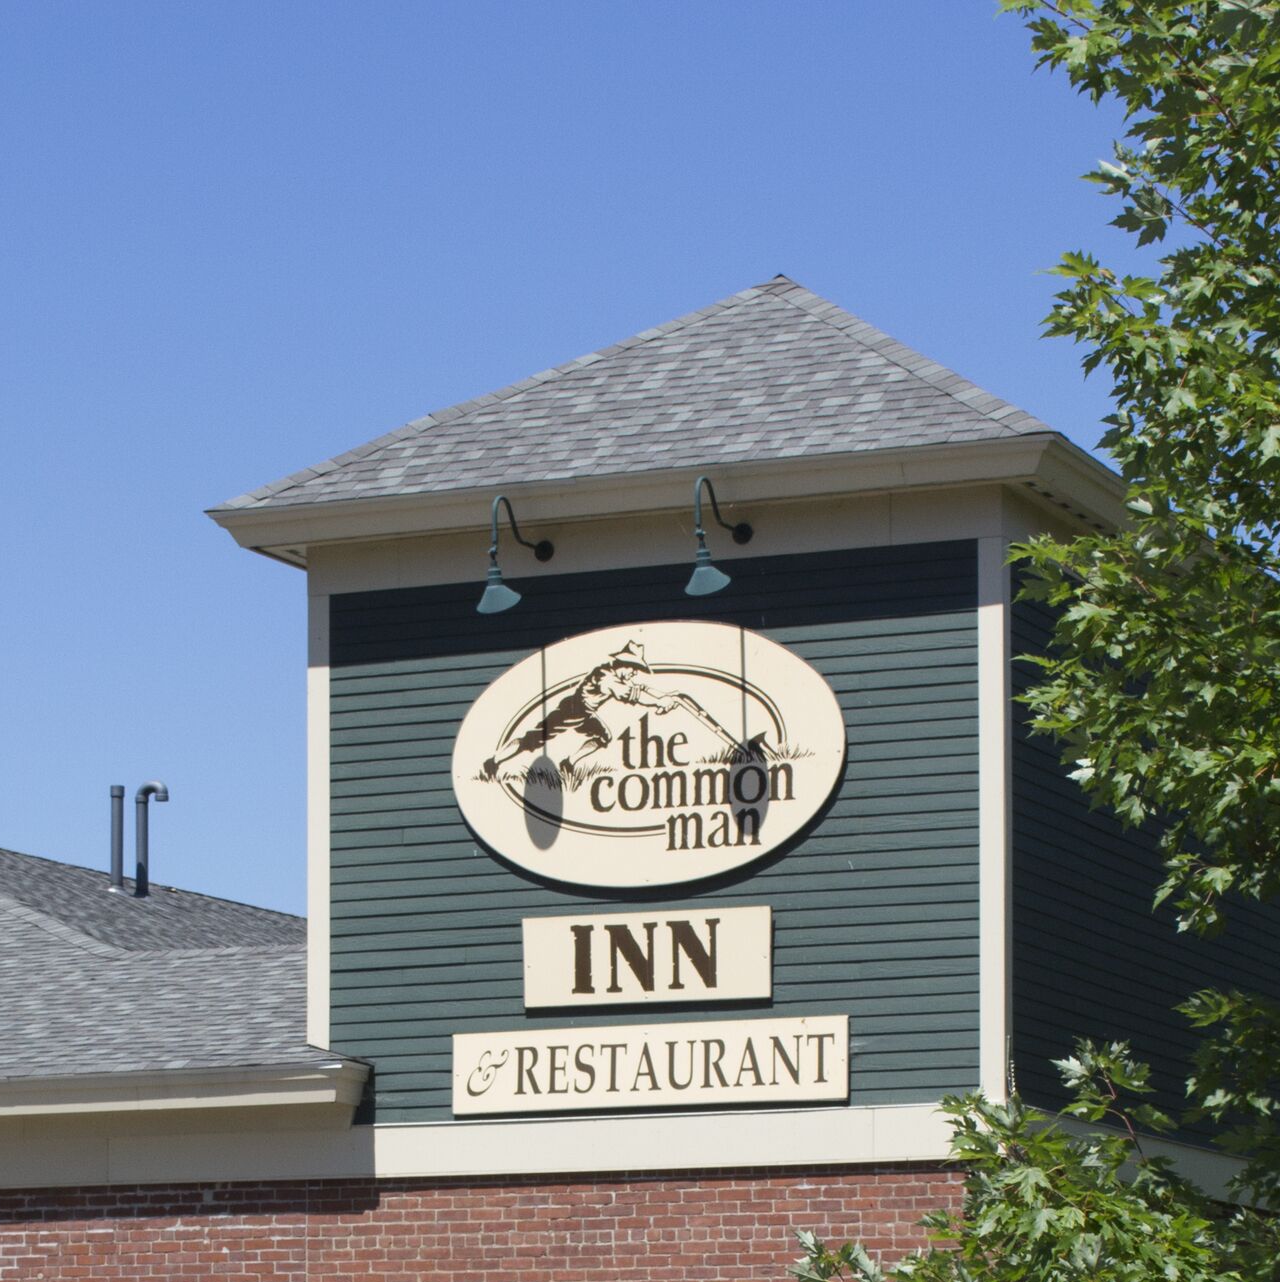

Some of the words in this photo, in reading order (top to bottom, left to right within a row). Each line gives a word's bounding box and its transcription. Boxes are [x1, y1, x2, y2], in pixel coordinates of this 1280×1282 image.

[617, 713, 690, 769] the
[590, 761, 796, 812] common
[666, 807, 762, 851] man
[570, 918, 720, 994] INN
[514, 1033, 835, 1095] RESTAURANT
